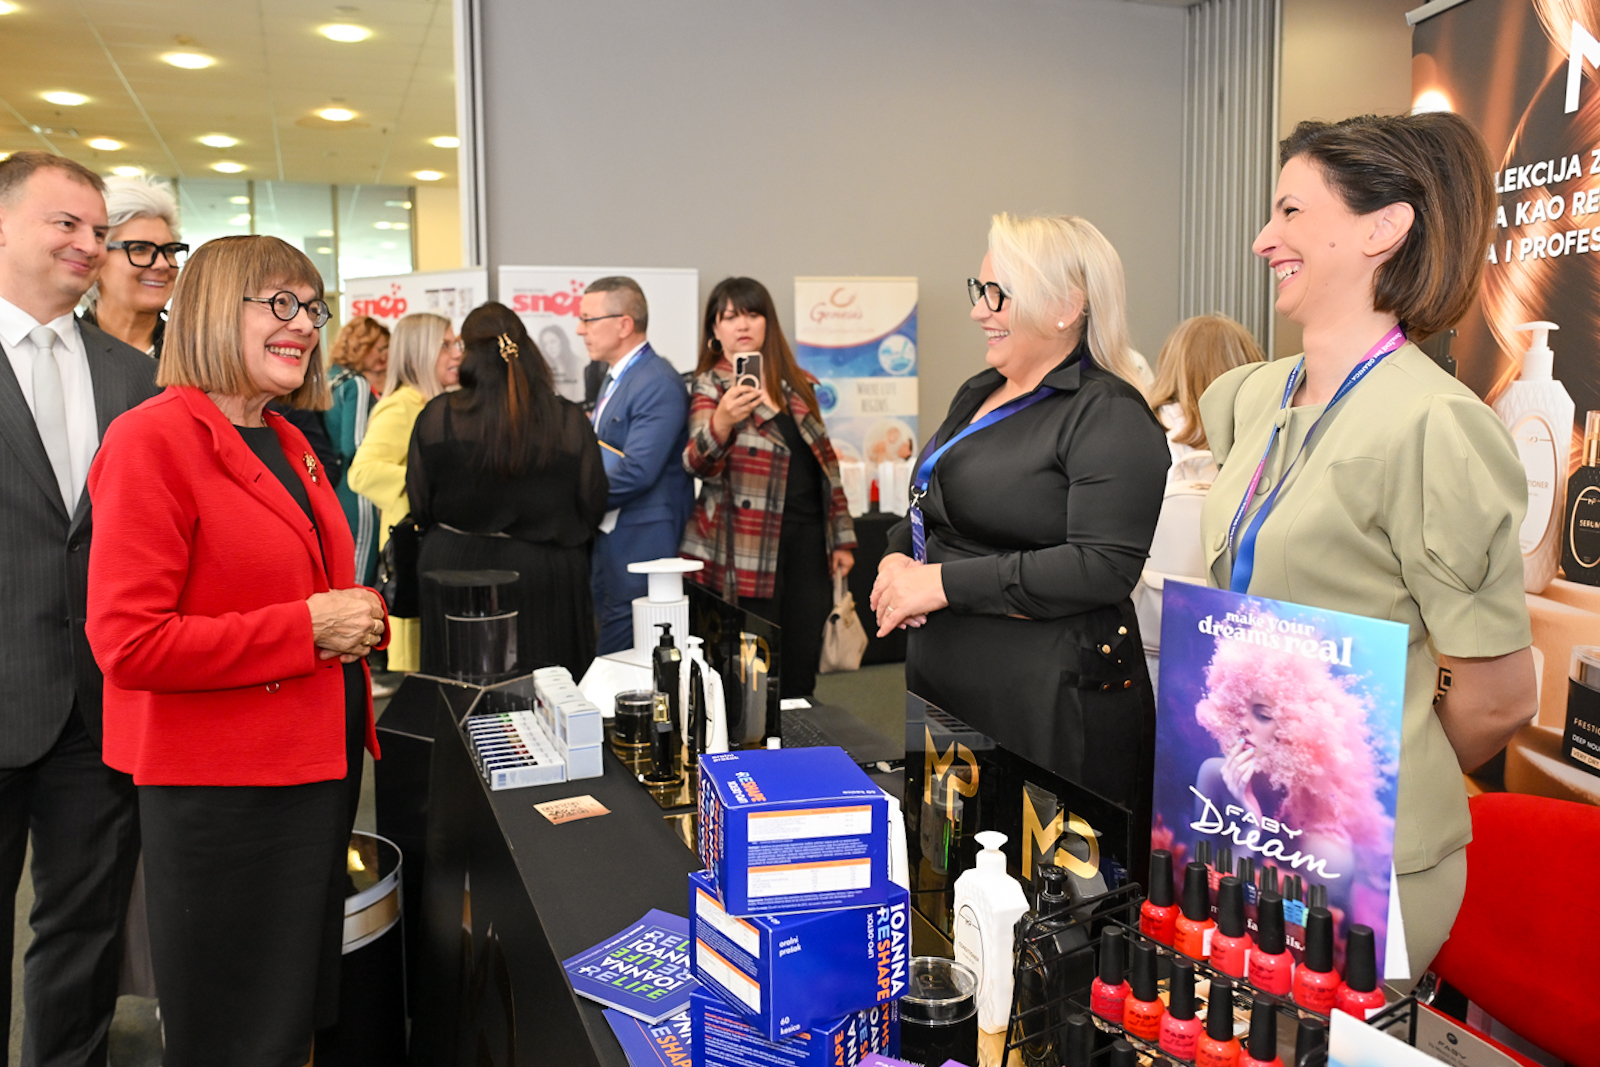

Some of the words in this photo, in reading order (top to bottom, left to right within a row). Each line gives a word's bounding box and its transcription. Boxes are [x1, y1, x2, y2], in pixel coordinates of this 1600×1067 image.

[1494, 154, 1582, 194] LEKCIJA
[1515, 195, 1565, 226] KAO
[1505, 239, 1512, 263] I
[1198, 615, 1280, 650] dreams
[1283, 636, 1353, 667] real
[1225, 611, 1265, 628] make
[1266, 616, 1315, 637] your
[1189, 784, 1341, 879] Dream
[1225, 804, 1303, 839] FABY
[890, 902, 905, 997] IOANNA
[601, 956, 685, 990] IOANNA
[780, 1016, 790, 1026] 60
